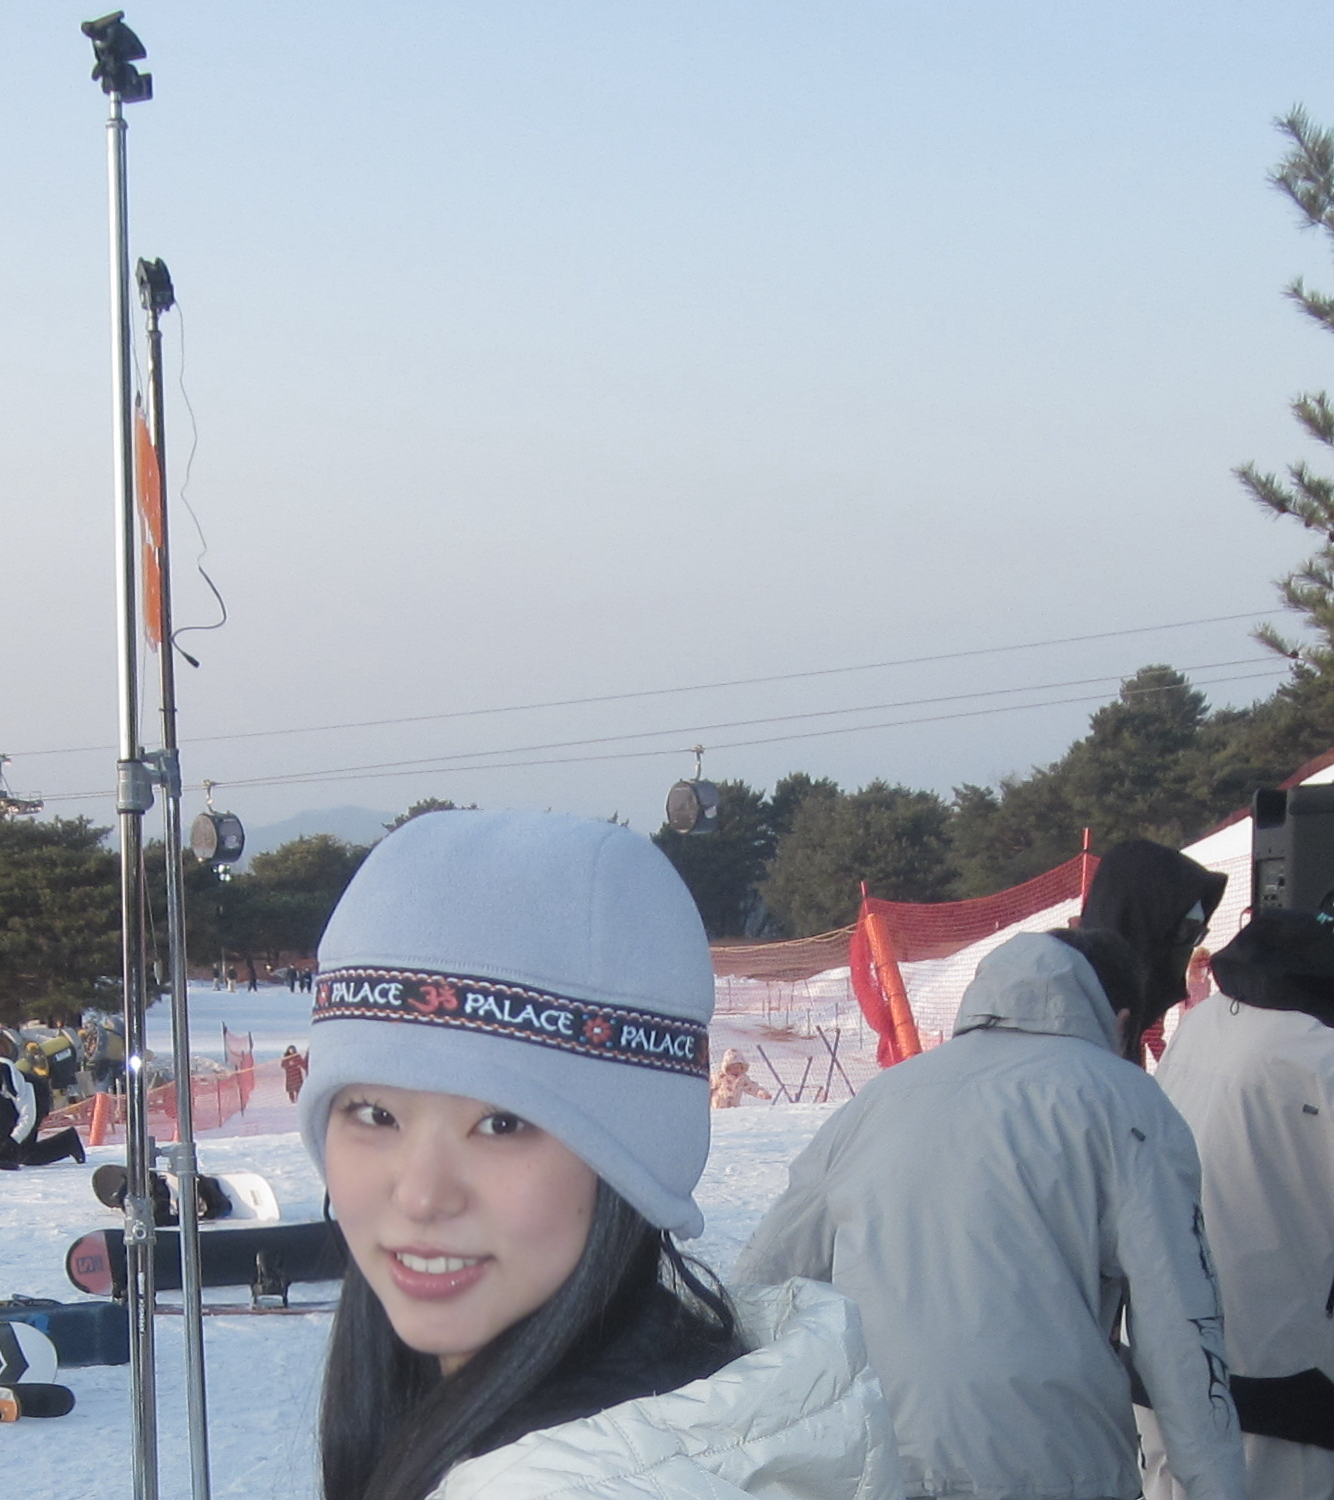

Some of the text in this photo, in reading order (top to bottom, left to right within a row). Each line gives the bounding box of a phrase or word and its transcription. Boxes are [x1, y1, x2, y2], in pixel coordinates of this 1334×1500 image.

[331, 981, 403, 1007] PALACE
[464, 992, 573, 1035] PALACE
[620, 1025, 694, 1059] PALACE
